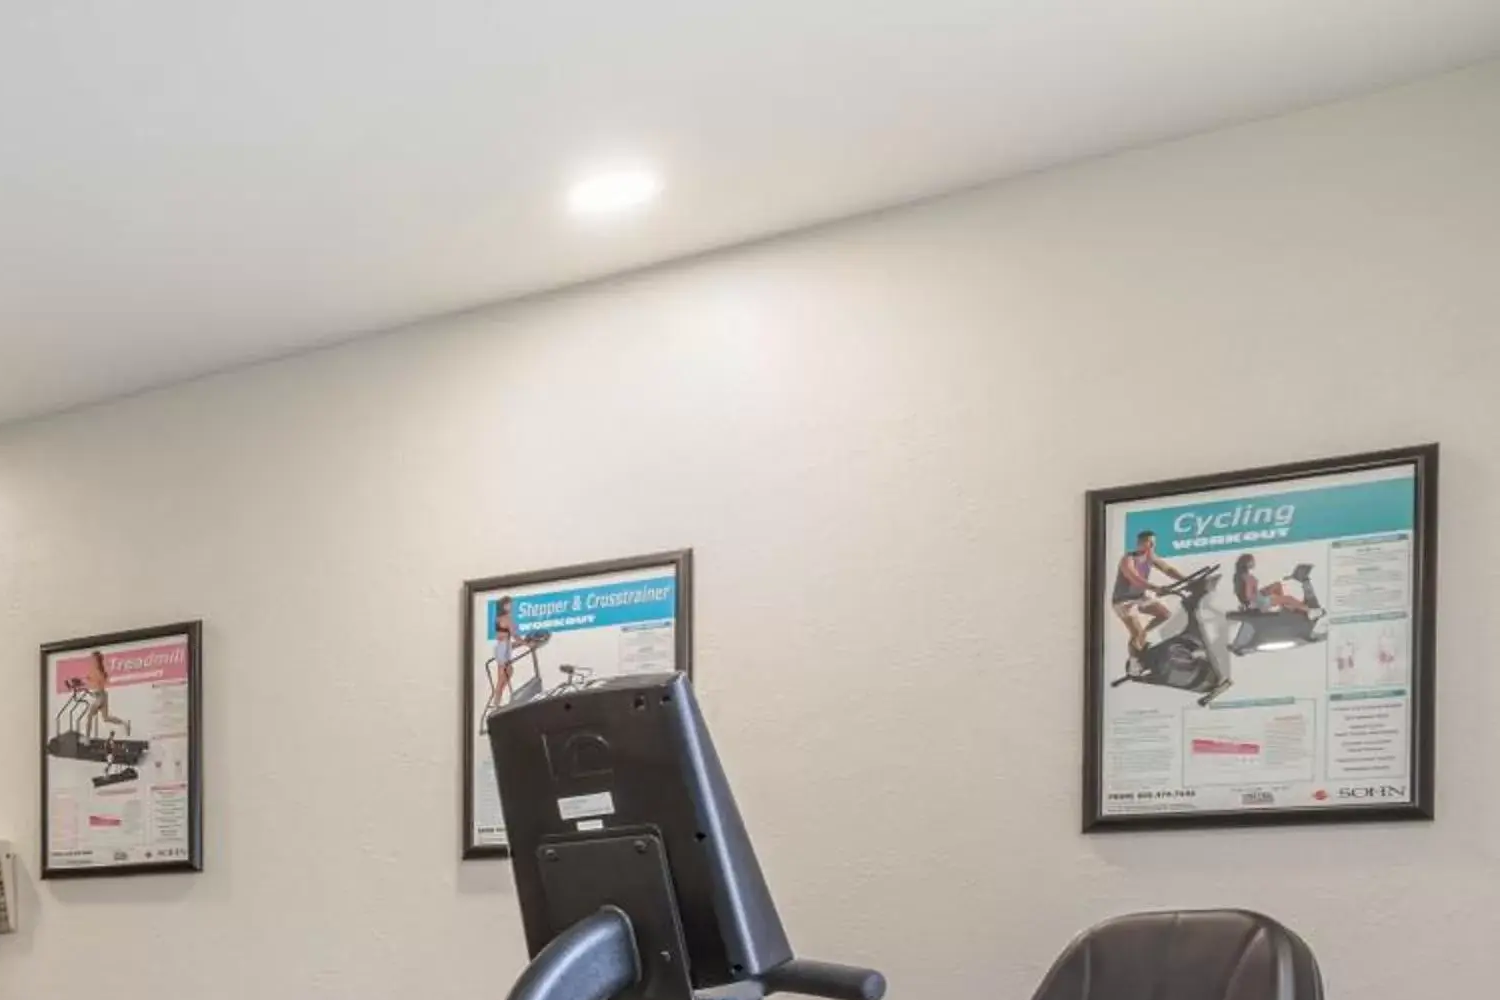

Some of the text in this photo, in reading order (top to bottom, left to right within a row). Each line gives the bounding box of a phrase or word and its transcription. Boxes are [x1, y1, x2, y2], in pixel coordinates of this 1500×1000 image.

[1173, 504, 1296, 535] Cycling
[1171, 527, 1291, 550] WORKOUT
[518, 585, 670, 618] Stepper & Crosstrainer
[110, 647, 185, 670] Treadmill
